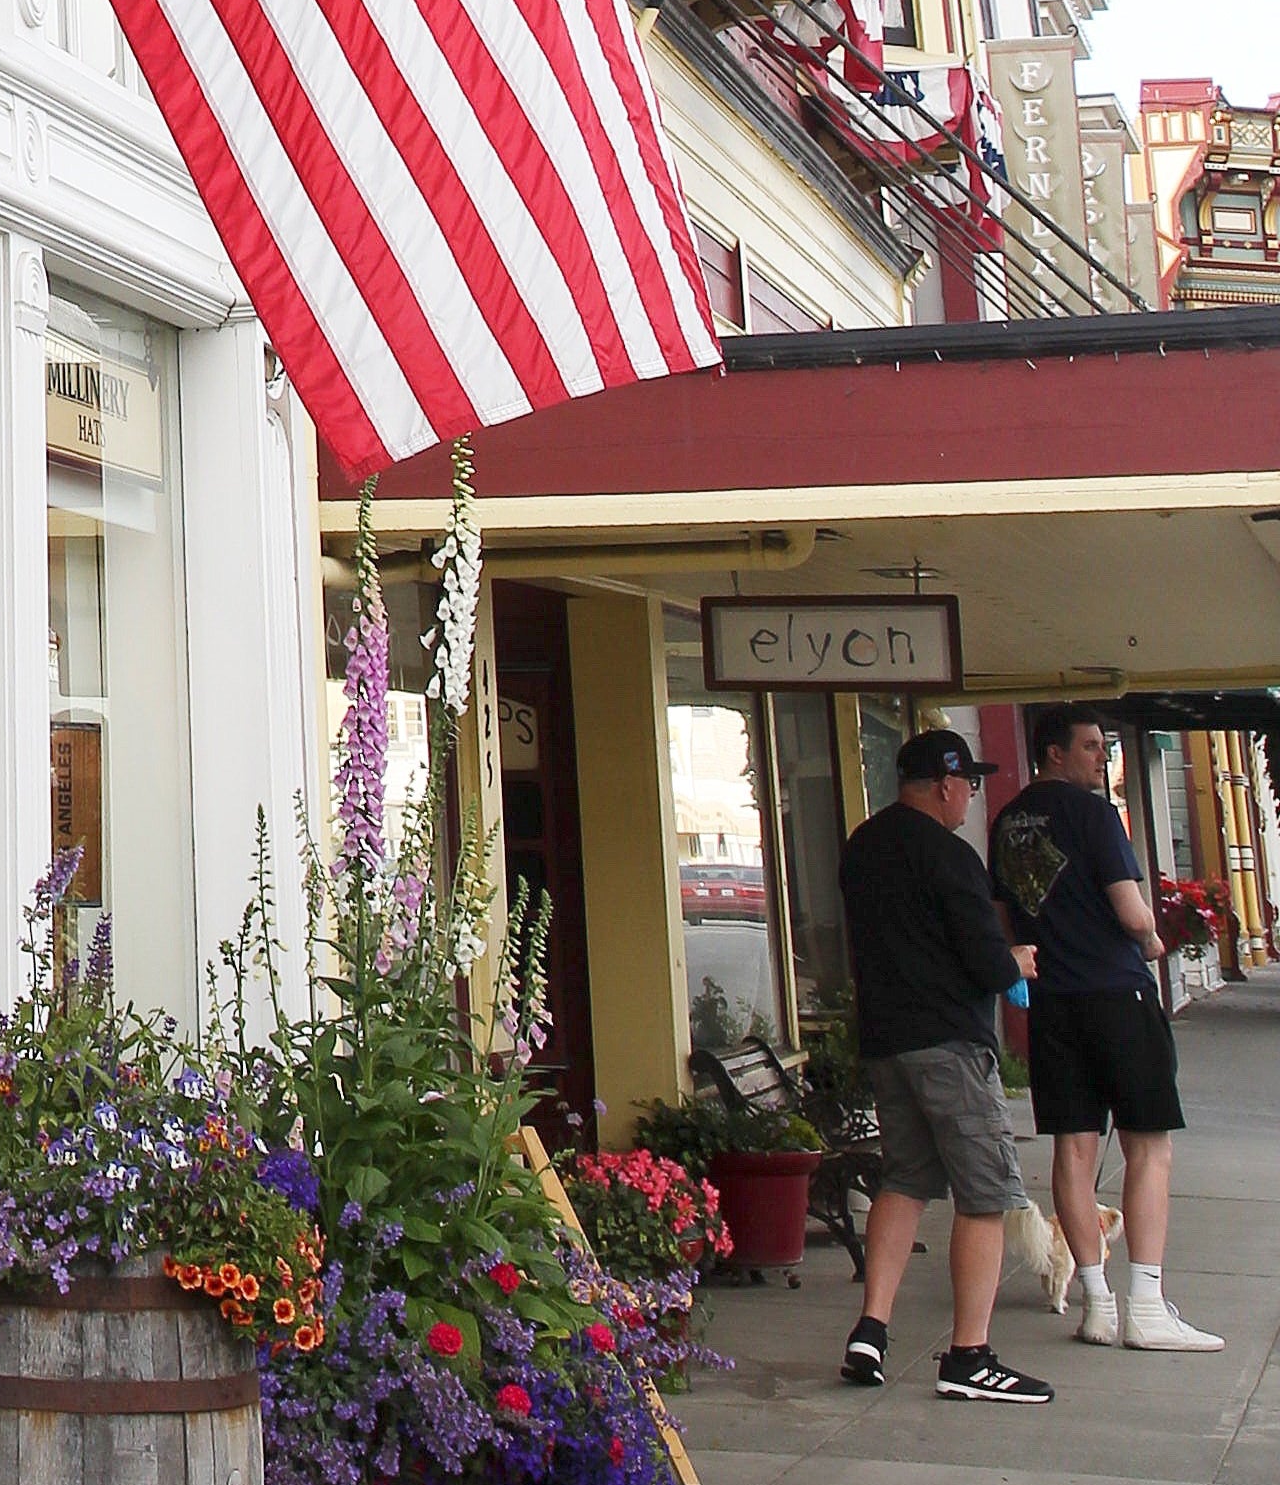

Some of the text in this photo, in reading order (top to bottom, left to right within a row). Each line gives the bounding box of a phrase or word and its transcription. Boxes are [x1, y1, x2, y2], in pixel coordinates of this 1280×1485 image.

[47, 362, 130, 421] MILLINERY
[78, 414, 107, 447] HATS
[749, 614, 917, 676] elyon
[56, 741, 74, 836] ANGELES
